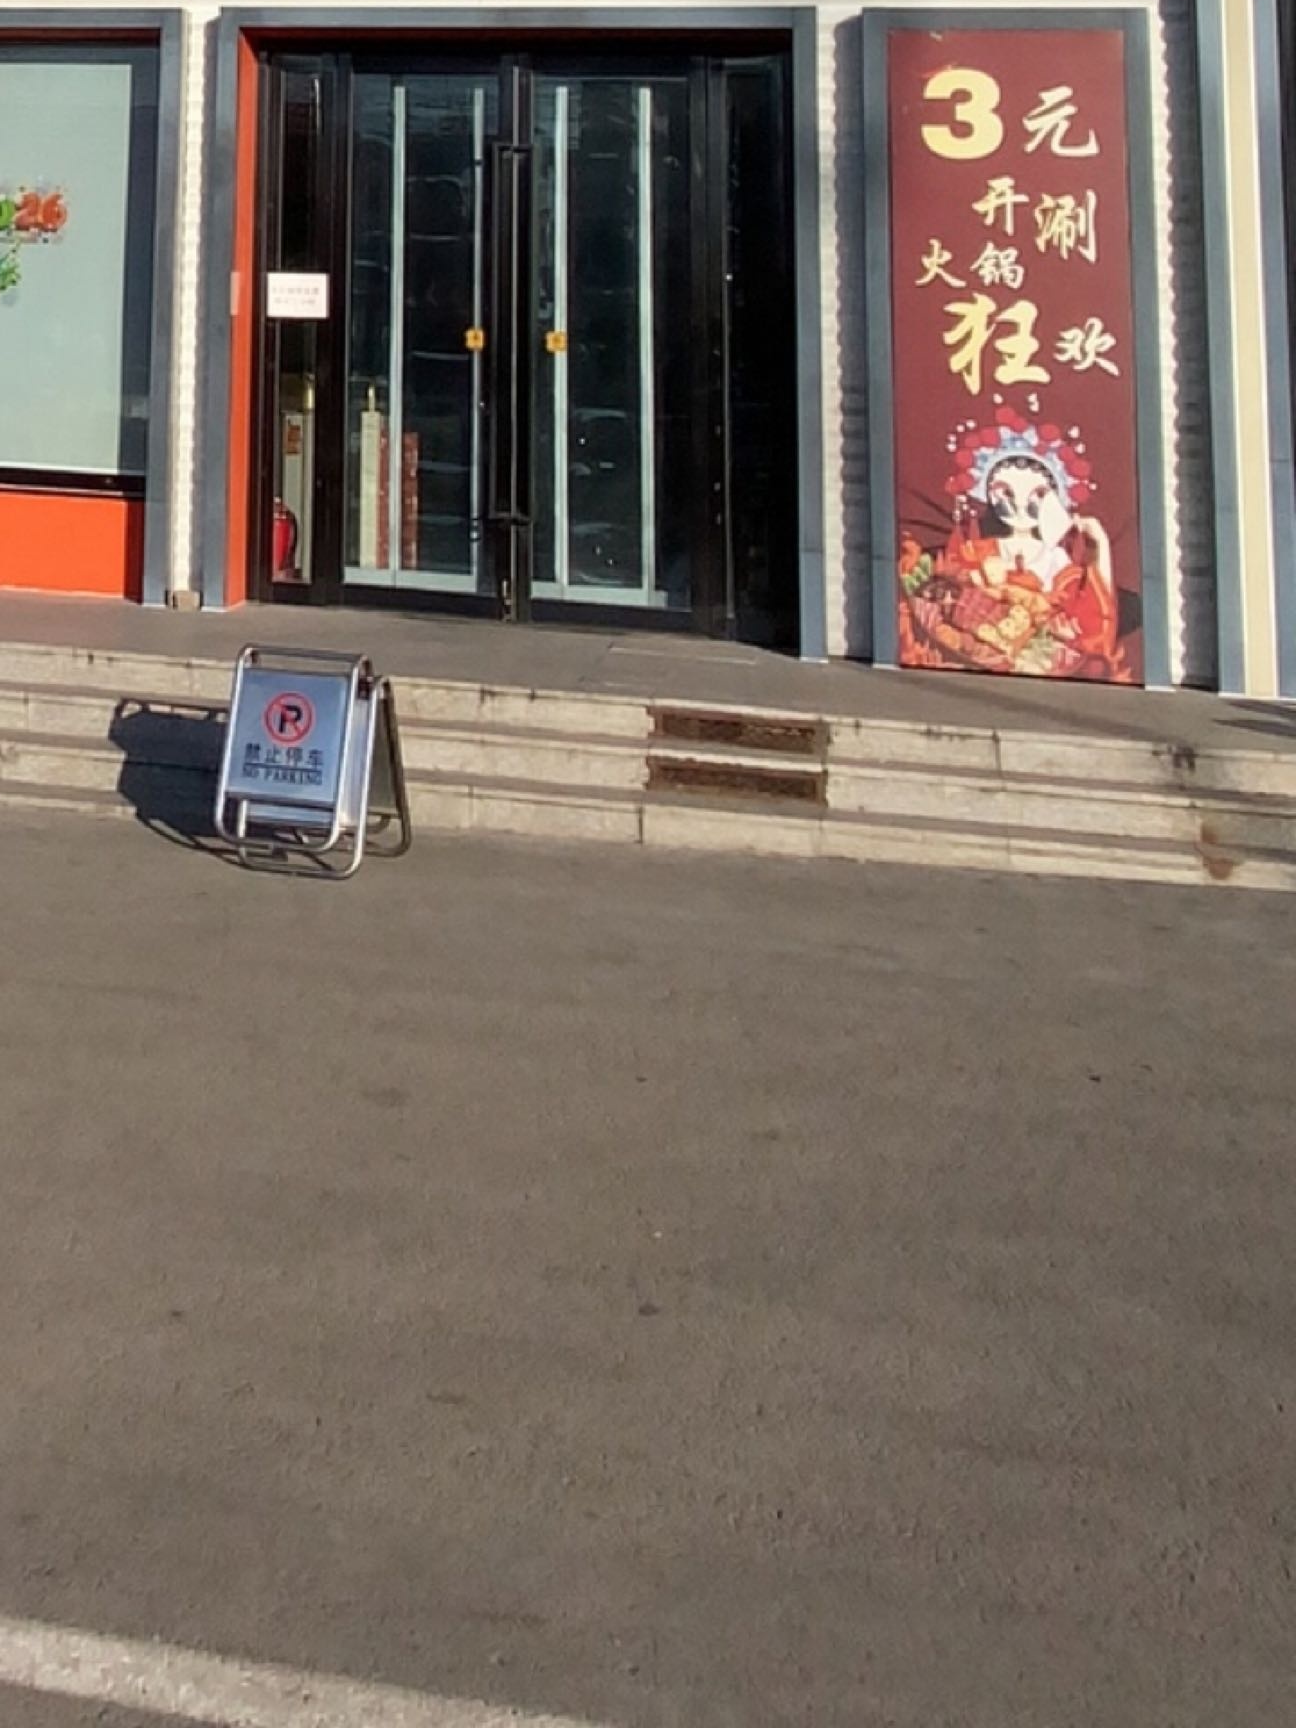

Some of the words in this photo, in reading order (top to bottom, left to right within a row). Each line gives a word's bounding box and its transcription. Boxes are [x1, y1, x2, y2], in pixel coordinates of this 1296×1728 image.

[919, 67, 1102, 160] 3元
[914, 239, 1025, 289] 火锅
[972, 175, 1098, 263] 开涮
[942, 292, 1120, 396] 狂欢
